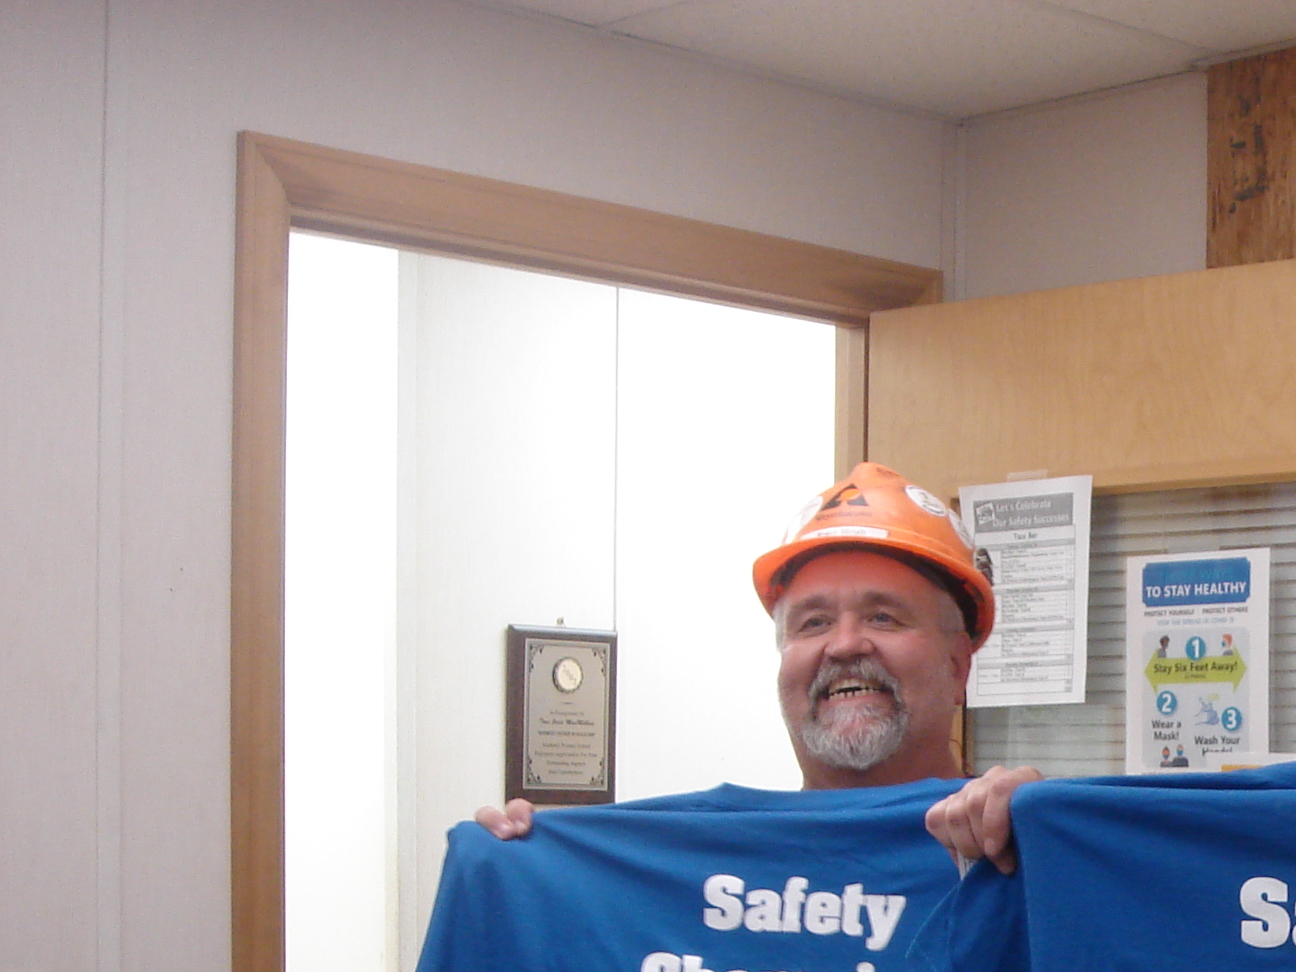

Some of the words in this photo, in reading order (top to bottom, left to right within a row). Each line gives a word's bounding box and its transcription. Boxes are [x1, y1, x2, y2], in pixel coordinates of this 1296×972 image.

[1146, 585, 1161, 598] TO
[1163, 584, 1191, 598] STAY
[1194, 581, 1247, 596] HEALTHY
[1191, 639, 1200, 659] 1
[1153, 662, 1172, 675] Stay
[1174, 662, 1187, 673] Six
[1190, 661, 1209, 672] Feet
[1210, 660, 1238, 673] Away!
[1161, 693, 1172, 713] 2
[1151, 719, 1174, 729] Wear
[1176, 721, 1182, 729] a
[1226, 709, 1237, 729] 3
[1153, 731, 1179, 741] Mask!
[1194, 735, 1218, 745] Wash
[1220, 735, 1240, 745] Your
[703, 874, 907, 951] Safety
